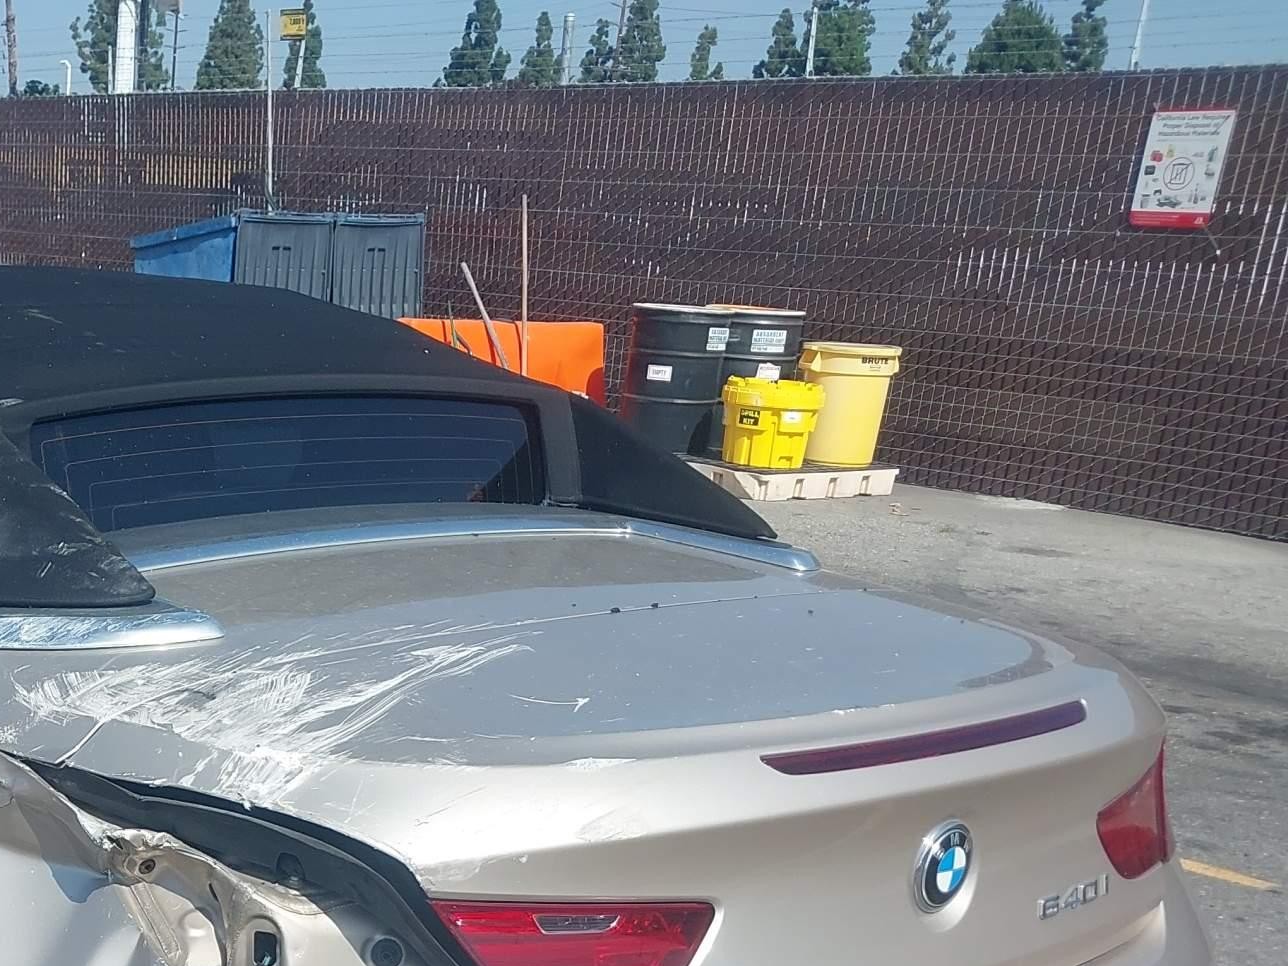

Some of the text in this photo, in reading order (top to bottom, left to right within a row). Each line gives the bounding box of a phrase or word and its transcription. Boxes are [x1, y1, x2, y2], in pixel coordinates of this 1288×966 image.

[862, 356, 889, 365] BRUTE
[740, 409, 760, 418] SPILL
[742, 417, 755, 425] KIT
